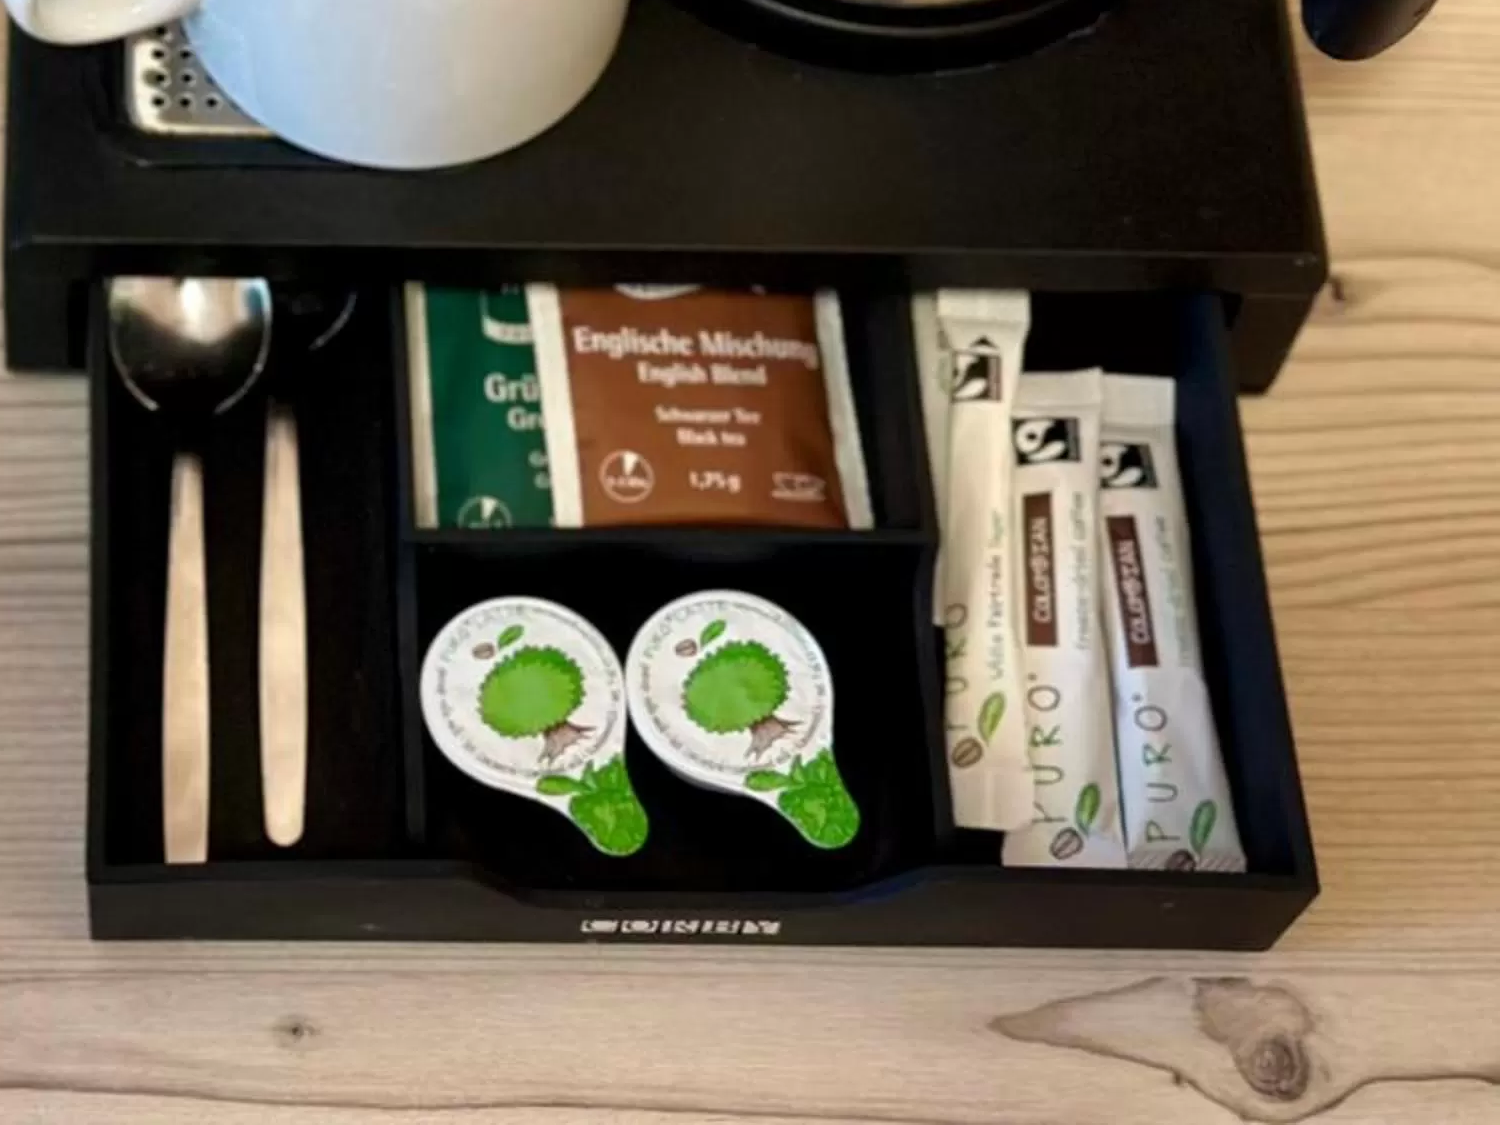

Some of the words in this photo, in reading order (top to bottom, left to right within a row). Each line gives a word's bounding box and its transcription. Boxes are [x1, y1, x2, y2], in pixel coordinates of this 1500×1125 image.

[572, 325, 695, 360] Englische
[698, 328, 820, 370] Mischung
[637, 361, 708, 388] English
[1134, 704, 1182, 844] PURO
